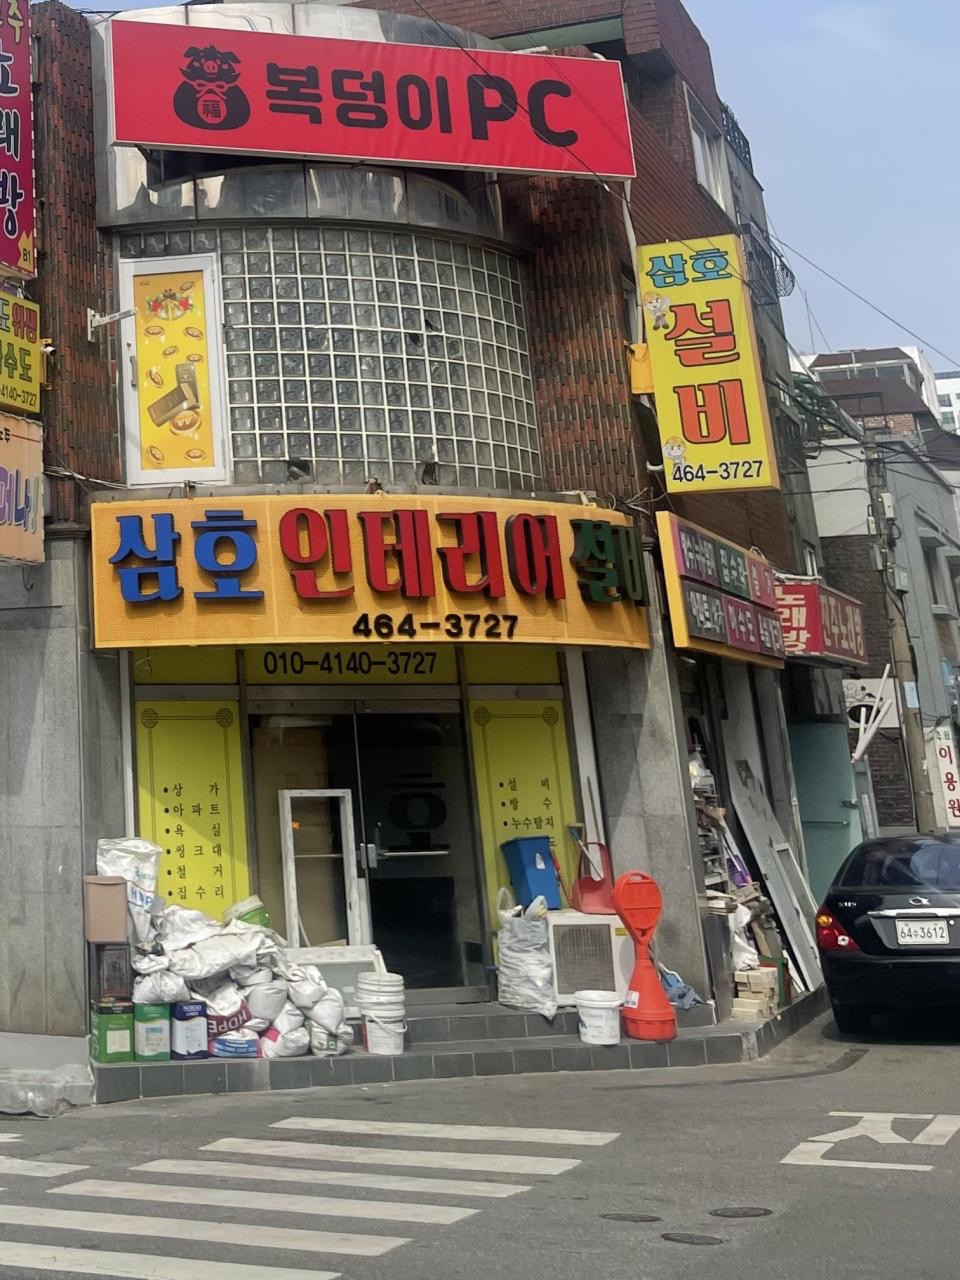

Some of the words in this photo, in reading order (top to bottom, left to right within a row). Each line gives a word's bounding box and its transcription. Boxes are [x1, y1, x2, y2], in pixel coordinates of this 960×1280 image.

[22, 247, 31, 263] B1
[646, 248, 732, 288] 삼호
[664, 298, 751, 445] 설비
[672, 460, 763, 483] 464-3727
[109, 509, 264, 604] 삼호
[279, 507, 567, 600] 인테리어
[569, 517, 650, 608] 설비
[352, 613, 519, 639] 464-3727
[775, 586, 811, 651] 노래방
[263, 651, 438, 675] 010-4140-3727
[511, 816, 554, 830] 누수탐지
